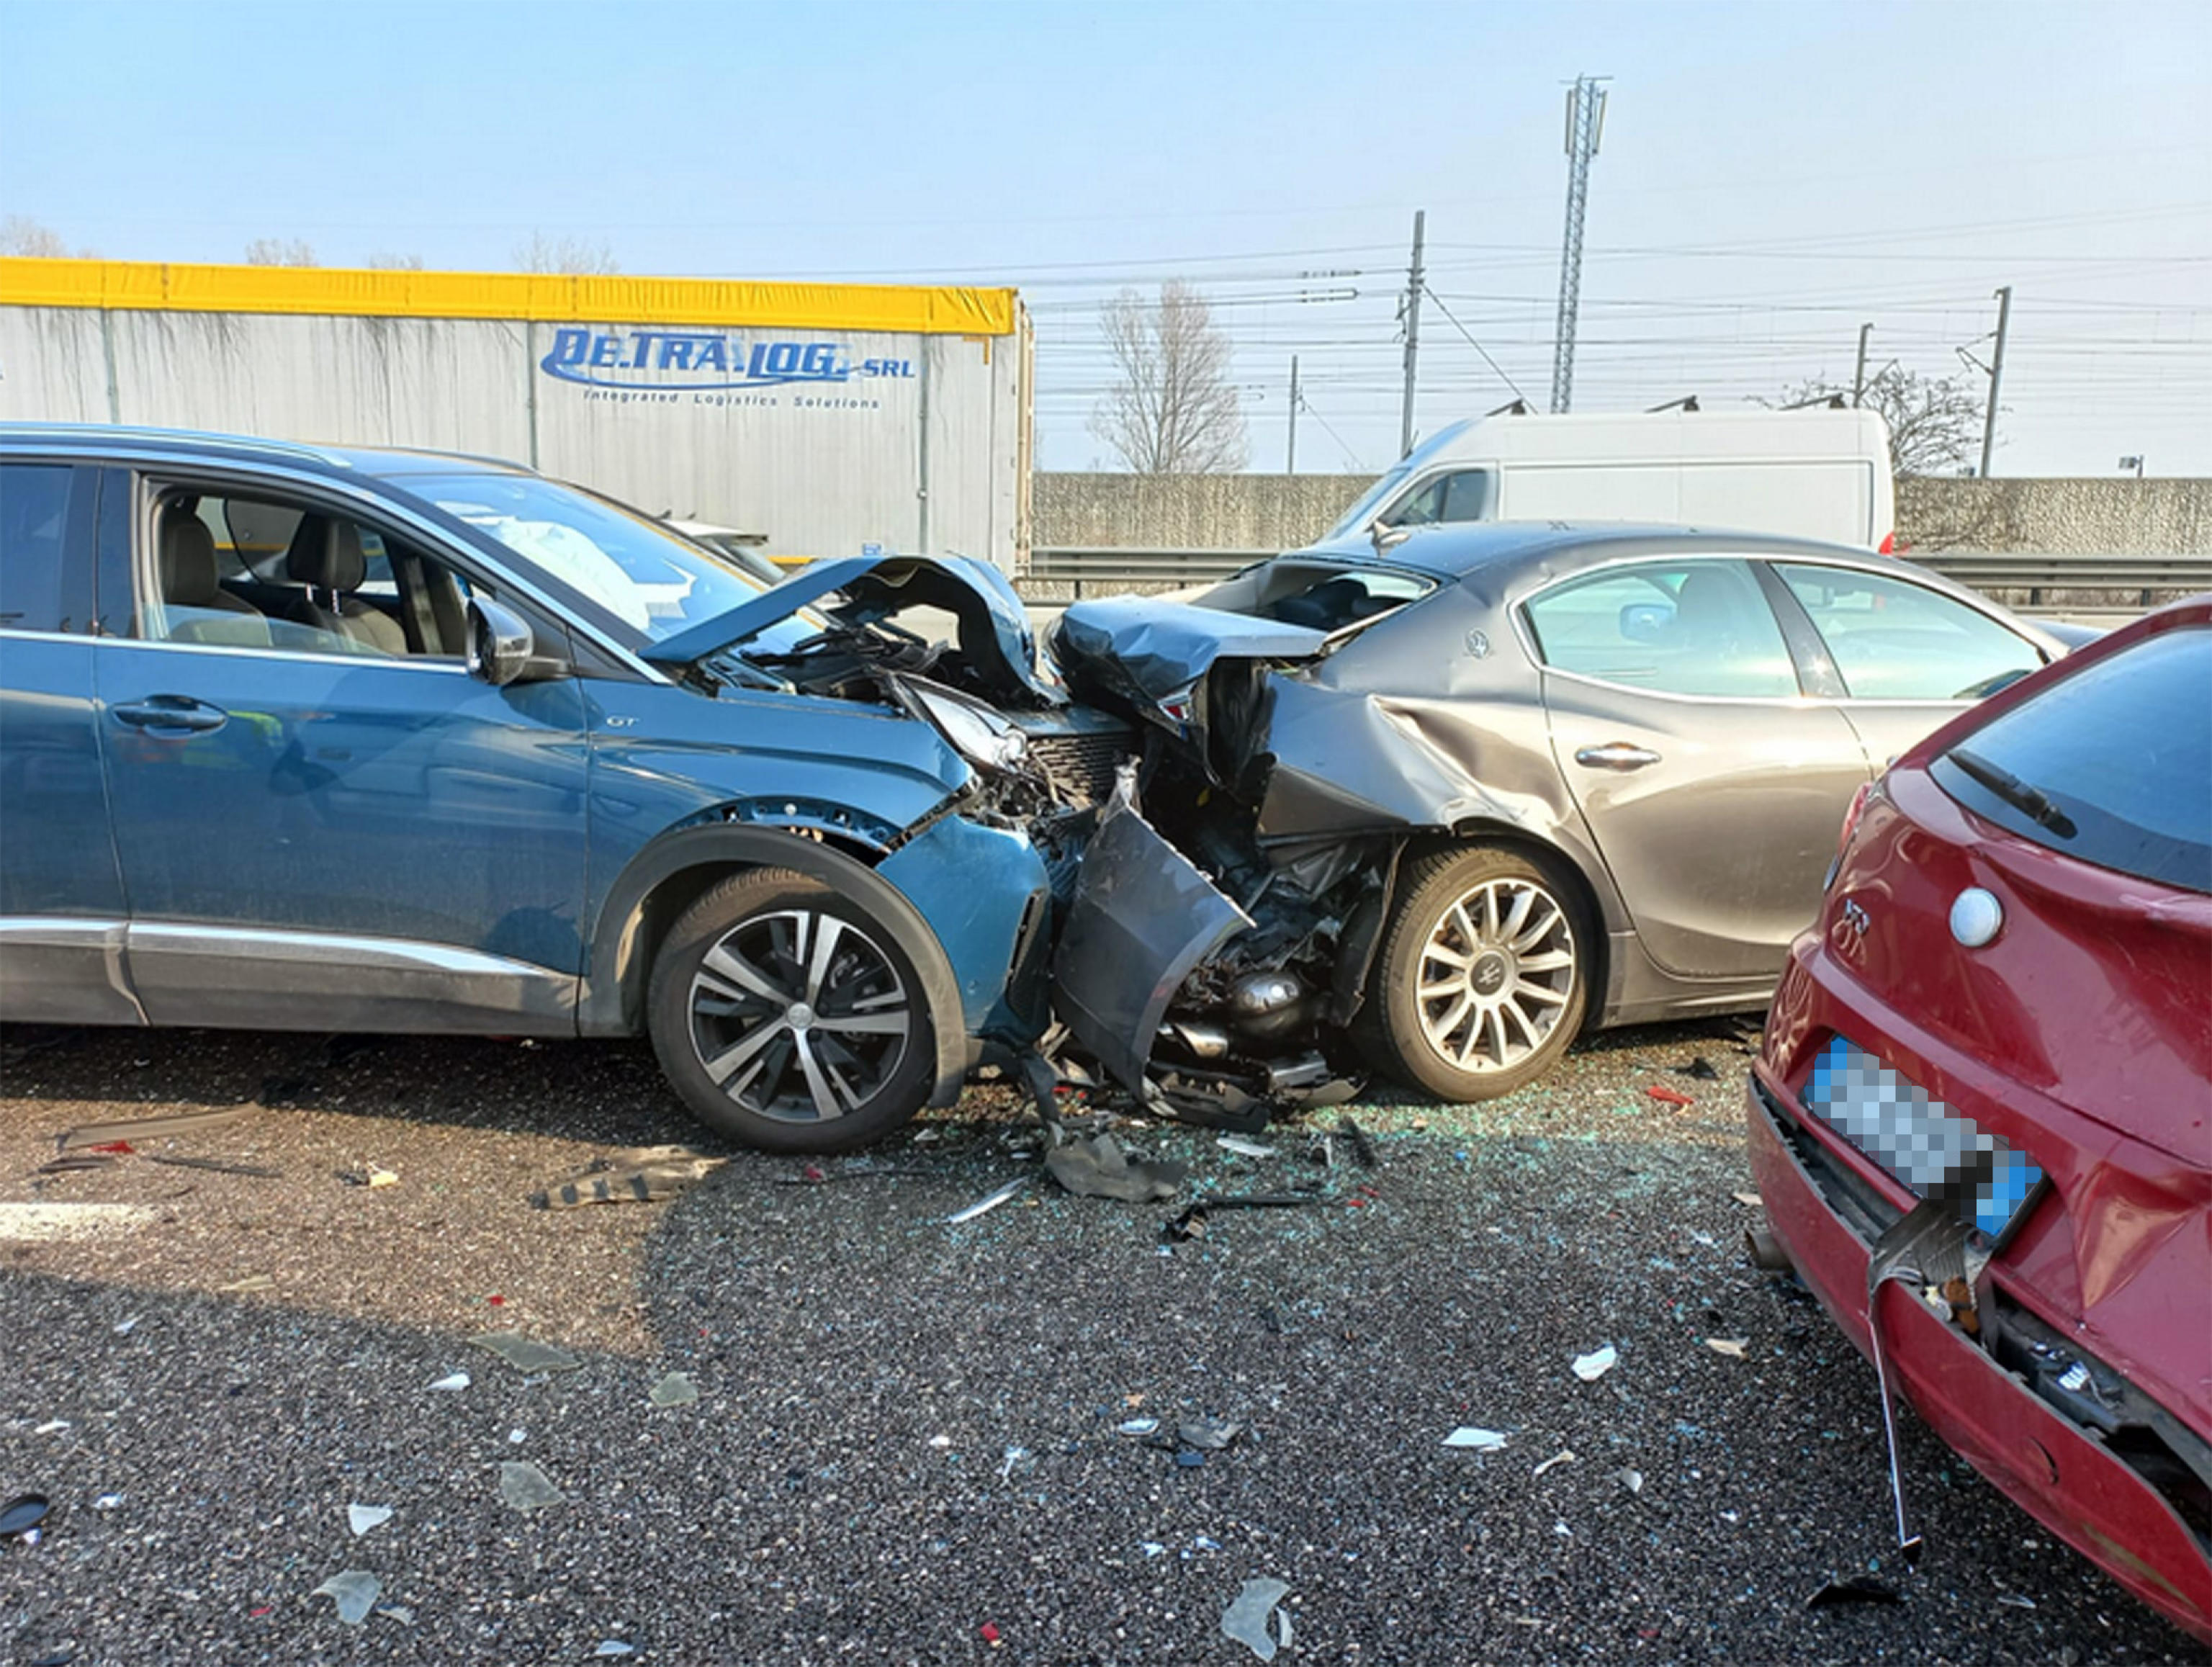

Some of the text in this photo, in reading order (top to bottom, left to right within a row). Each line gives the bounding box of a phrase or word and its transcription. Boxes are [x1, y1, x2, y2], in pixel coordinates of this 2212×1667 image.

[863, 359, 915, 378] SRL
[583, 390, 880, 409] Integrated Logistics Solutions
[606, 716, 639, 727] GT
